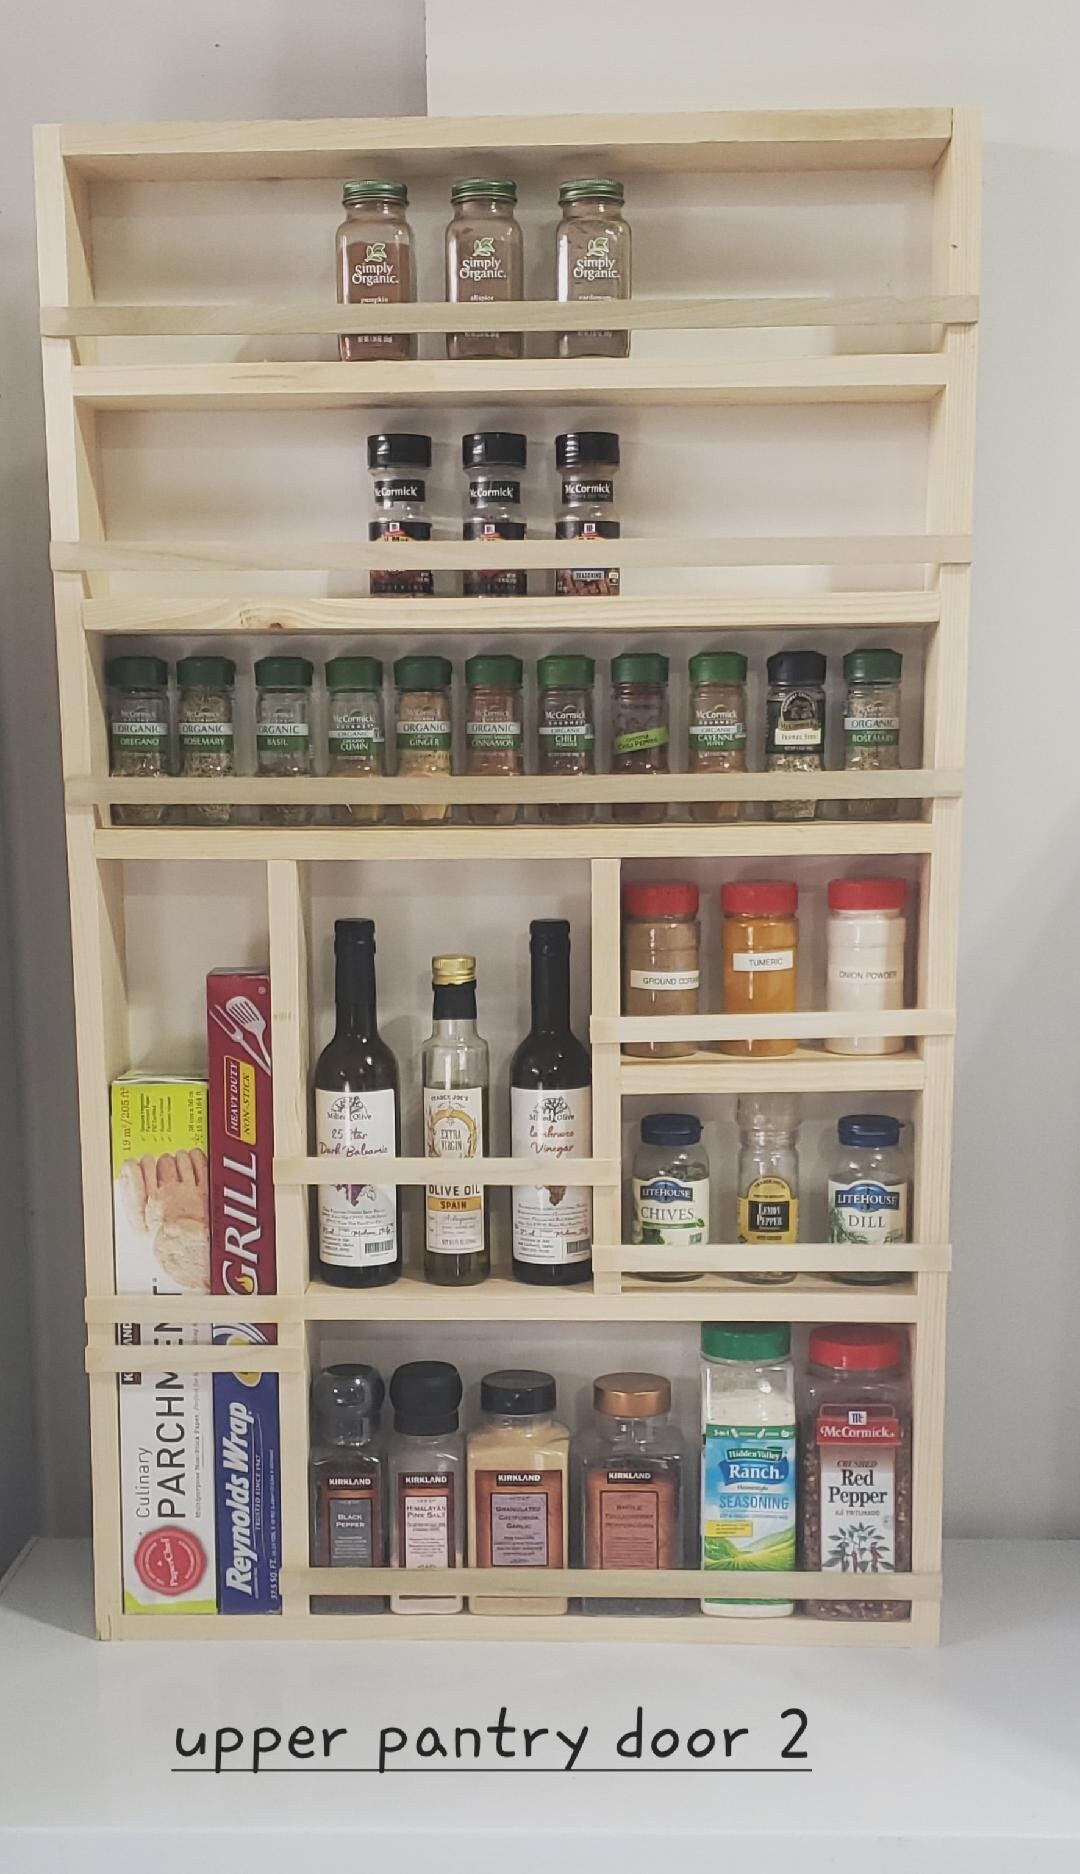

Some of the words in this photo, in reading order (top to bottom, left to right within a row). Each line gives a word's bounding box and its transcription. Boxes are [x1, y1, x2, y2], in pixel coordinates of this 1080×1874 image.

[462, 257, 502, 273] Simply
[576, 257, 616, 273] Simply
[355, 263, 394, 279] Simply
[565, 482, 610, 494] McCormick
[545, 711, 586, 719] McCormick
[696, 709, 738, 719] McCormick
[117, 725, 161, 733] ORGANIC
[182, 725, 224, 733] ORGANIC
[403, 723, 446, 732] ORGANIC
[471, 723, 514, 732] ORGANIC
[851, 719, 895, 729] ORGANIC
[258, 725, 299, 734] ORGANIC
[184, 738, 225, 746] ROSEMARY
[267, 738, 288, 746] BASIL
[409, 738, 440, 746] GINGER
[555, 735, 577, 743] CHILI
[697, 733, 735, 742] CAYENNE
[340, 742, 369, 751] CUMIN
[471, 739, 514, 747] CINNAMON
[748, 957, 784, 968] TUMERIC
[839, 970, 863, 979] ONION
[865, 970, 897, 979] POWDER
[643, 977, 677, 986] GROUND
[230, 1061, 238, 1093] DUTY
[242, 1071, 251, 1135] NON-STICK
[230, 1093, 239, 1131] HEAVY
[441, 1129, 461, 1139] EXTRA
[121, 1140, 132, 1152] 19
[441, 1141, 462, 1151] VIRGIN
[429, 1184, 460, 1196] OLIVE
[464, 1184, 480, 1195] OIL
[642, 1188, 692, 1198] LITEHOUSE
[837, 1194, 897, 1205] LITEHOUSE
[440, 1201, 467, 1210] SPAIN
[640, 1206, 694, 1221] CHIVES
[223, 1152, 261, 1295] GRILL
[756, 1214, 782, 1226] PEPPER
[848, 1214, 887, 1228] DILL
[820, 1426, 890, 1438] McCormick
[222, 1402, 254, 1473] Wrap
[729, 1450, 757, 1458] Hidden
[758, 1450, 780, 1460] Valley
[836, 1460, 878, 1468] CRUSHED
[405, 1476, 447, 1484] KIRKLAND
[498, 1474, 541, 1482] KIRKLAND
[608, 1472, 651, 1480] KIRKLAND
[840, 1469, 874, 1487] Red
[135, 1447, 153, 1518] Culinary
[827, 1486, 888, 1508] Pepper
[719, 1495, 790, 1510] SEASONING
[224, 1473, 258, 1596] Reynolds
